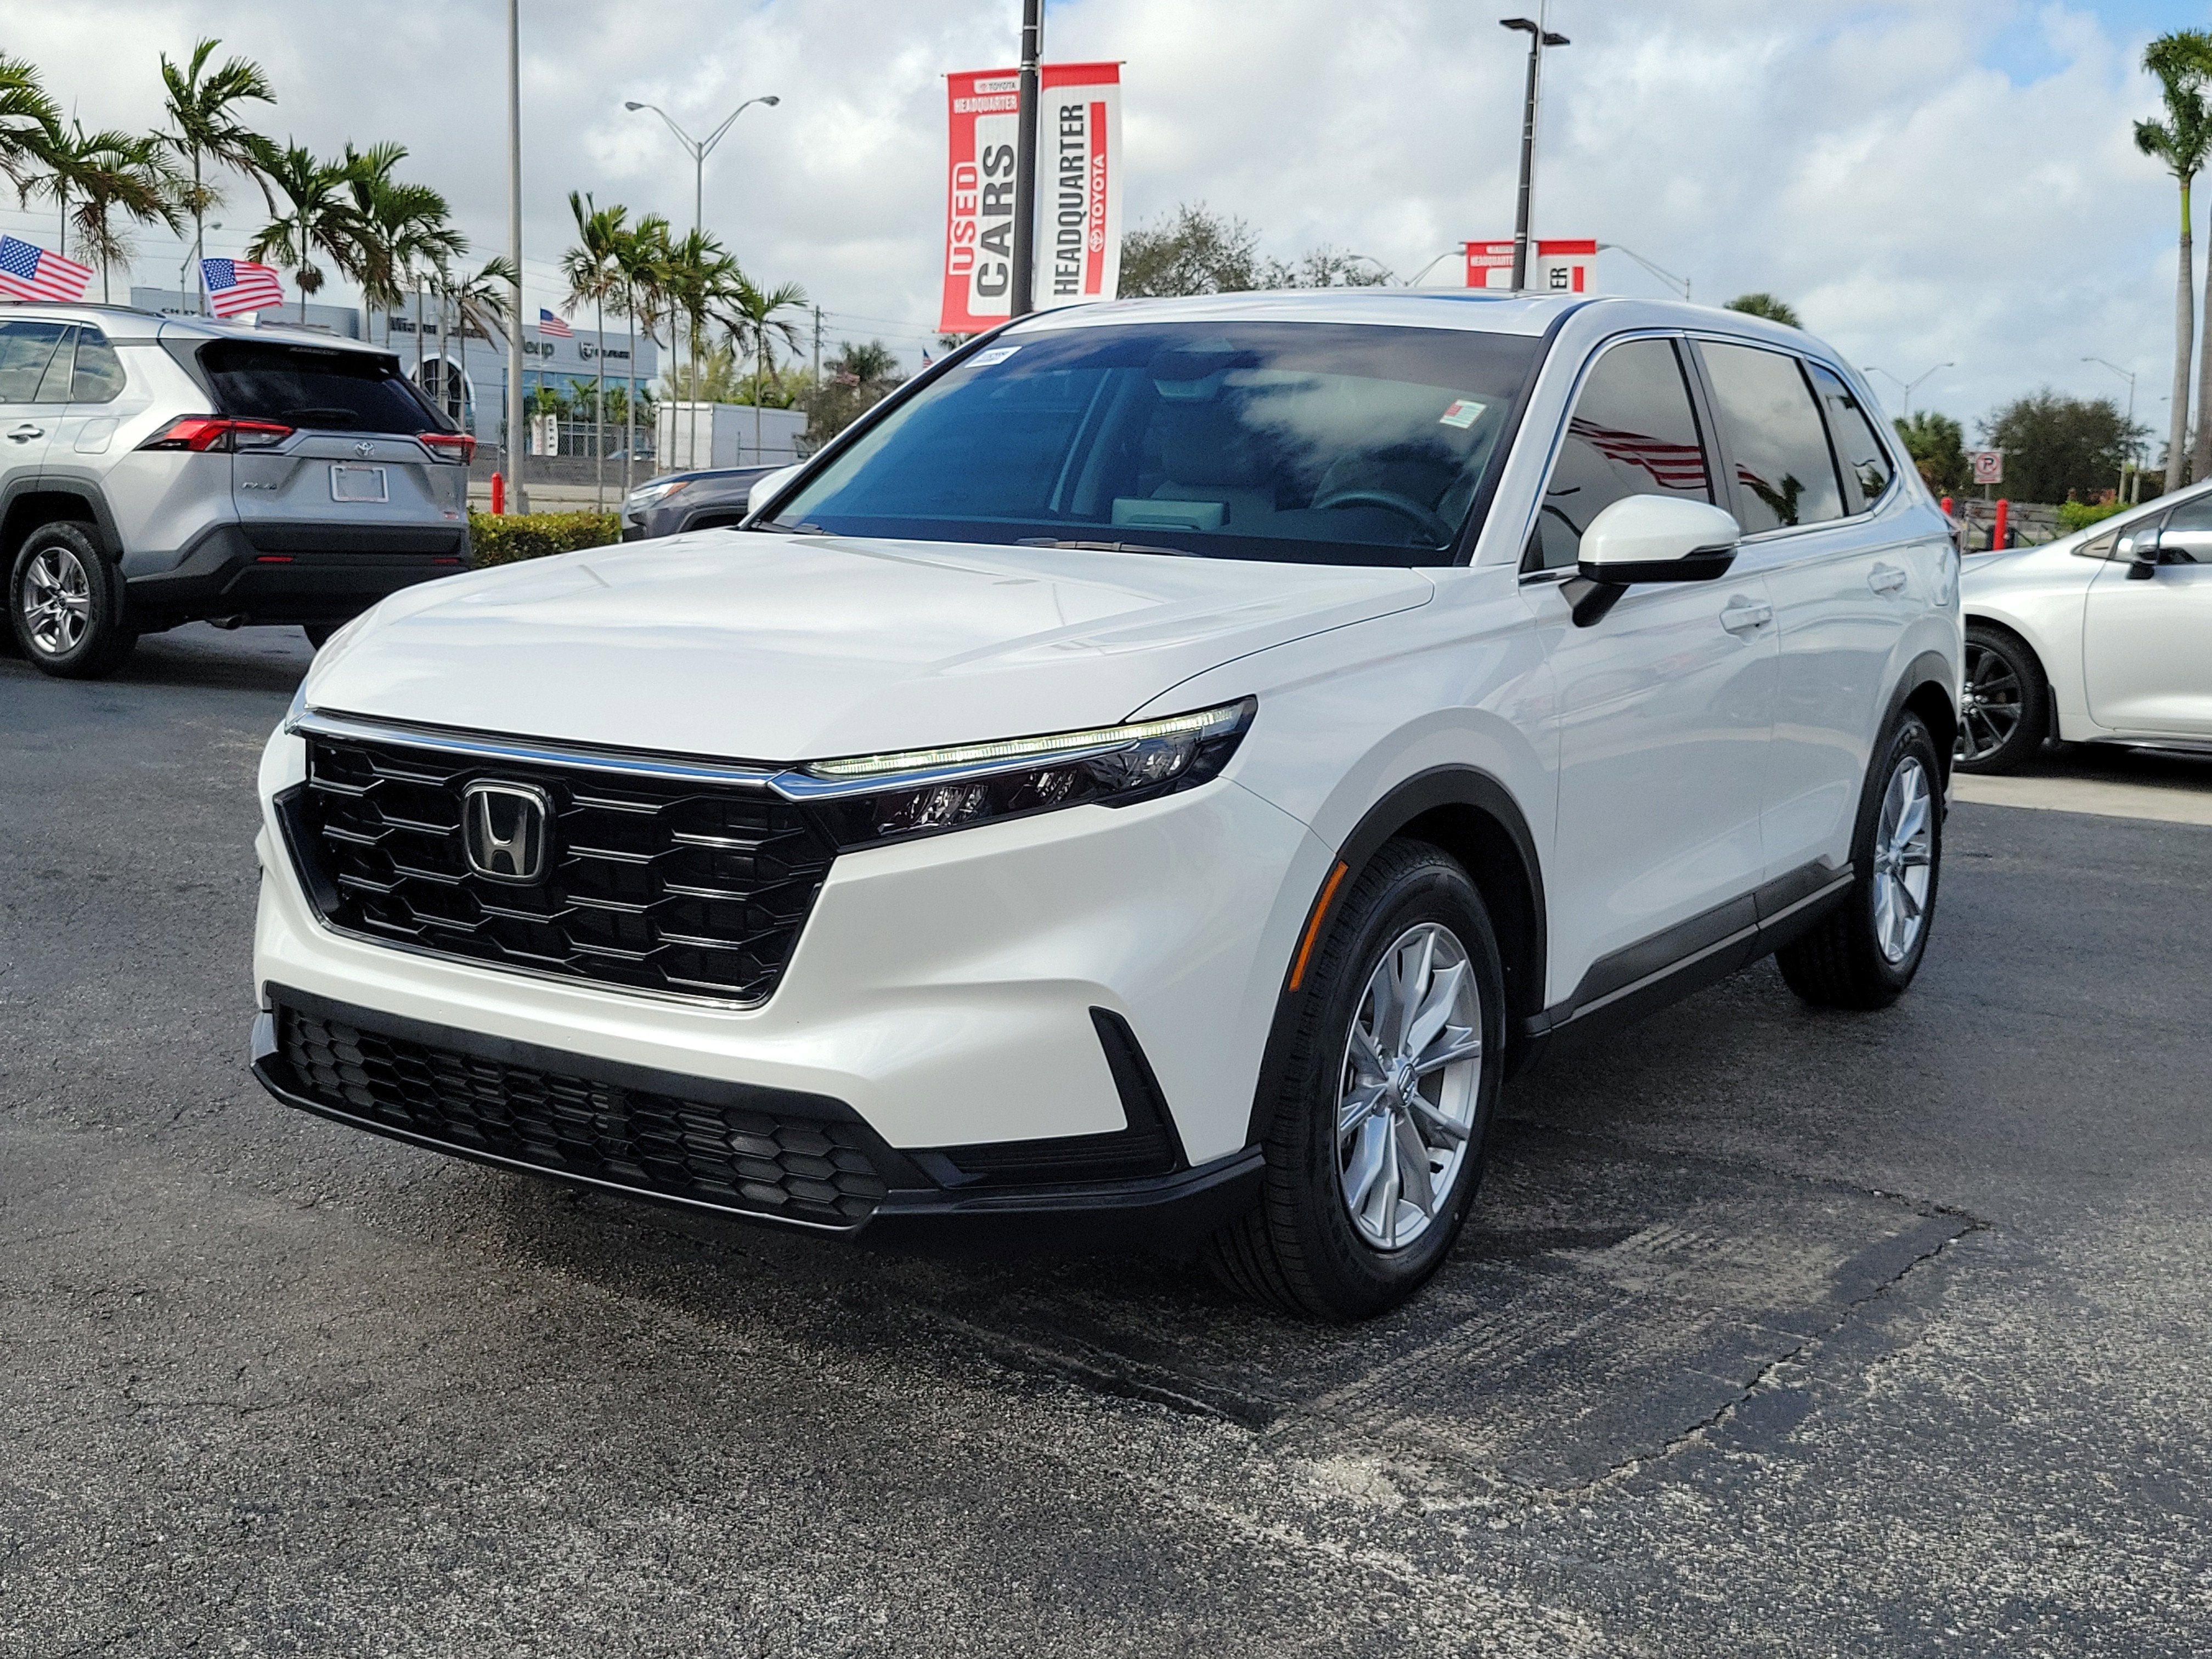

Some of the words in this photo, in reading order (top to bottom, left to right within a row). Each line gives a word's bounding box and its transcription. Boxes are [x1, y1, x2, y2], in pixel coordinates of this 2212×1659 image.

[988, 82, 1015, 91] TOYOTA
[950, 162, 977, 274] USED
[977, 144, 1014, 297] CARS
[1053, 104, 1087, 296] HEADQUARTER
[1091, 154, 1105, 227] TOYOTA
